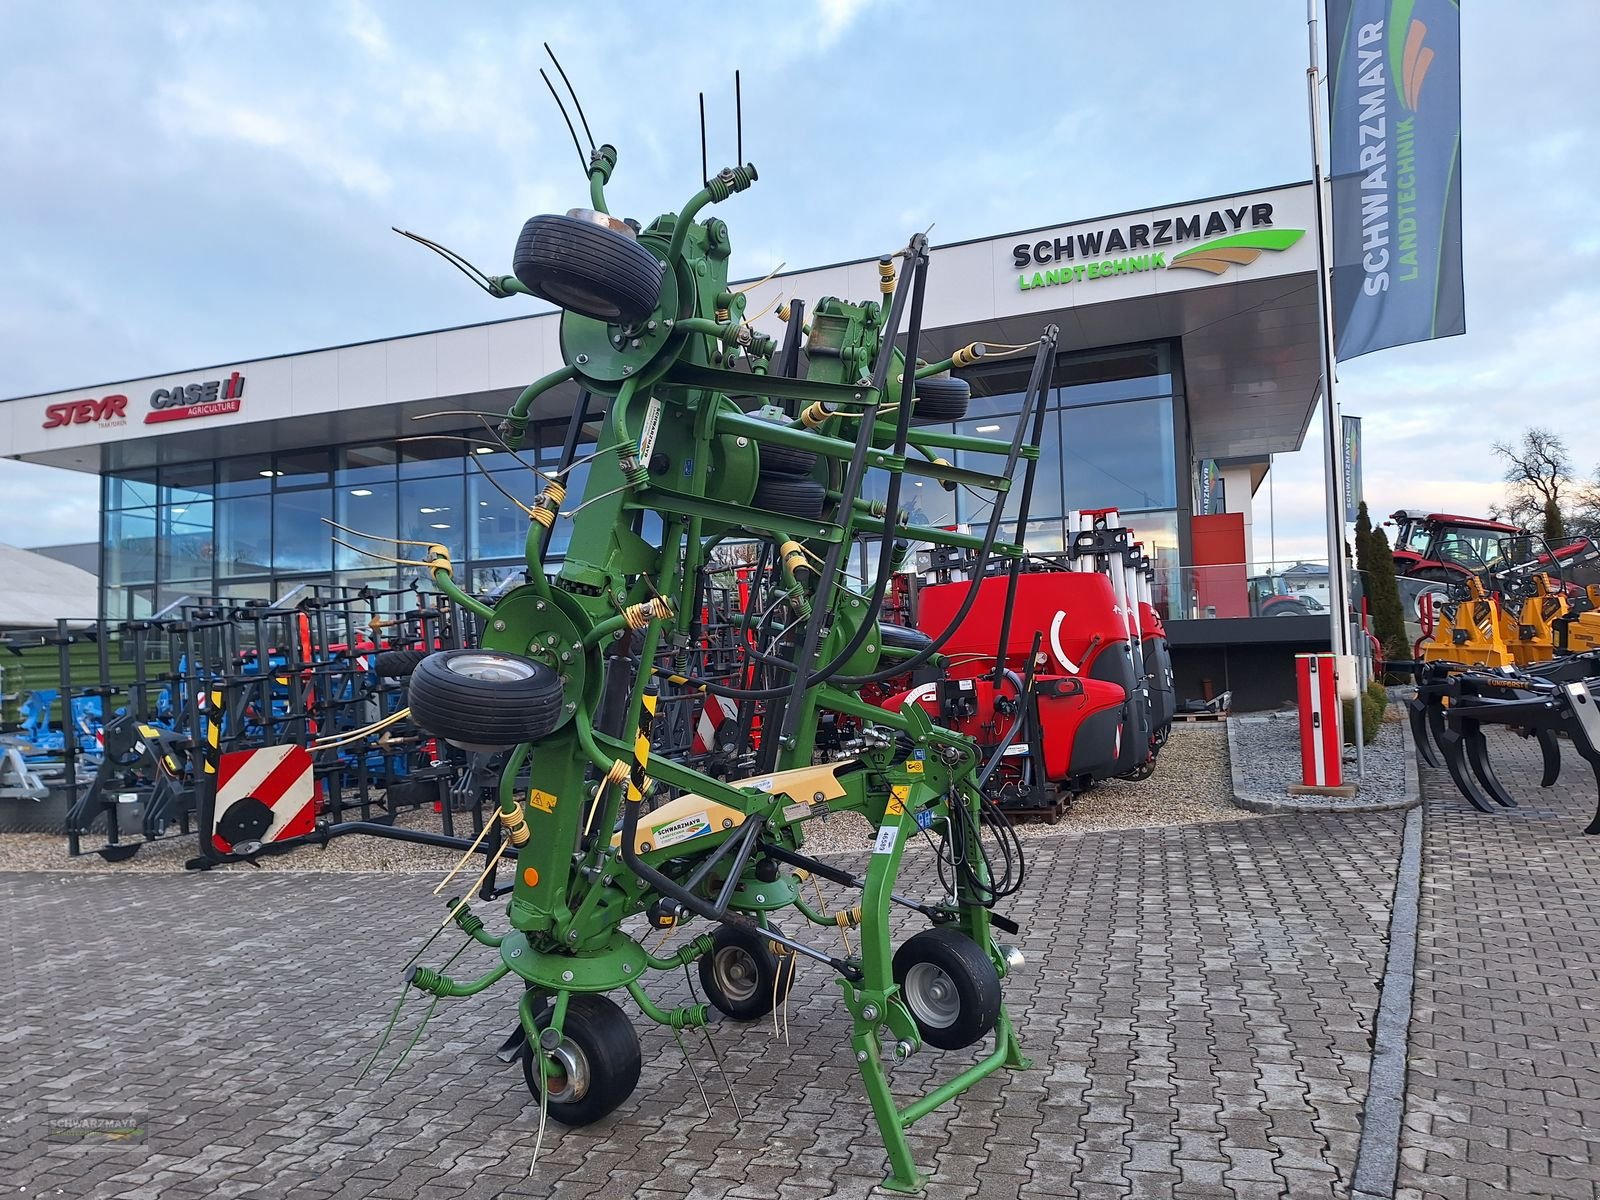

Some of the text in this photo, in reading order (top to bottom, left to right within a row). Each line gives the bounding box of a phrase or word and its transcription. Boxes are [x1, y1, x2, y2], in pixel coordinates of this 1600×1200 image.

[1358, 19, 1389, 297] SCHWARZMAYR
[1395, 115, 1419, 282] LANDTECHNIK
[1013, 202, 1274, 269] SCHWARZMAYR
[1019, 251, 1166, 291] LANDTECHNIK
[42, 394, 128, 429] STEYR
[150, 381, 221, 409] CASE
[187, 401, 237, 416] AGRICULTURE
[644, 407, 661, 458] SCHWARZMAYR
[657, 818, 701, 836] SCHWARZMAYR
